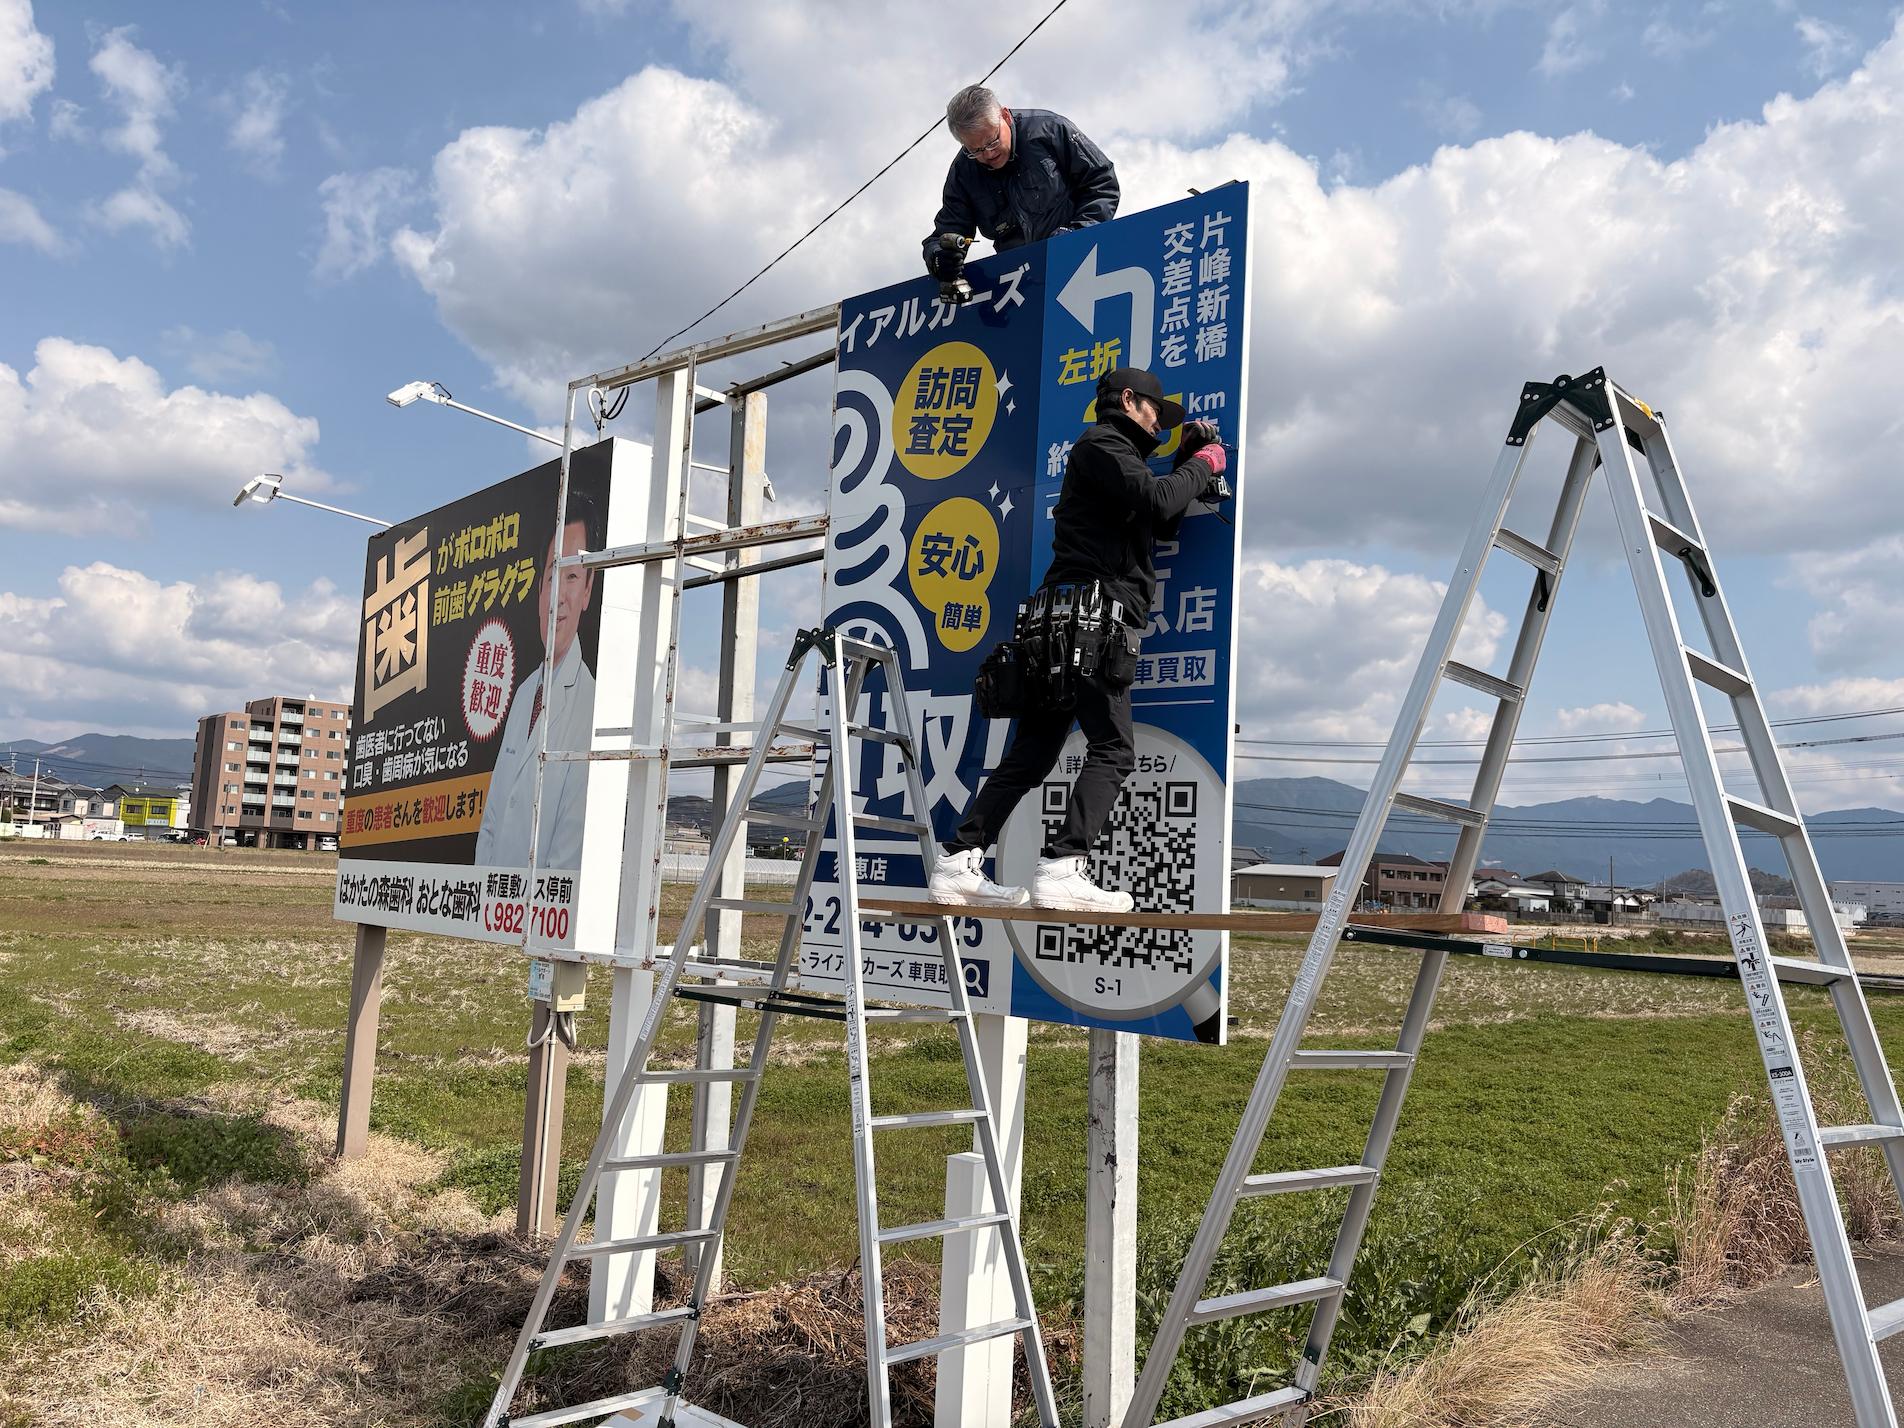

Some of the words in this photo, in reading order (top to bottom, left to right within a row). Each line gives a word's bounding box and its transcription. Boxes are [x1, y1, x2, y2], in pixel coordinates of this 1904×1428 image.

[1159, 221, 1195, 369] 交差点を
[1195, 209, 1232, 365] 片峰新橋
[1056, 337, 1122, 387] 左折
[913, 366, 982, 411] 訪問
[1188, 390, 1226, 415] km
[904, 412, 974, 458] 査定
[436, 512, 521, 576] がボロボロ
[918, 531, 985, 583] 安心
[432, 556, 537, 627] 前歯グラグラ
[364, 526, 432, 725] 歯
[941, 601, 982, 633] 簡単
[473, 640, 507, 680] 重度
[469, 679, 503, 720] 歓迎
[354, 715, 447, 761] 歯医者に行ってない
[353, 740, 469, 789] 口臭・歯周病が気になる
[345, 788, 484, 835] 重度の患者さんを歓迎します!
[338, 874, 414, 915] はかたの森歯科
[415, 881, 482, 923] おとな歯科
[1094, 976, 1122, 996] S-1
